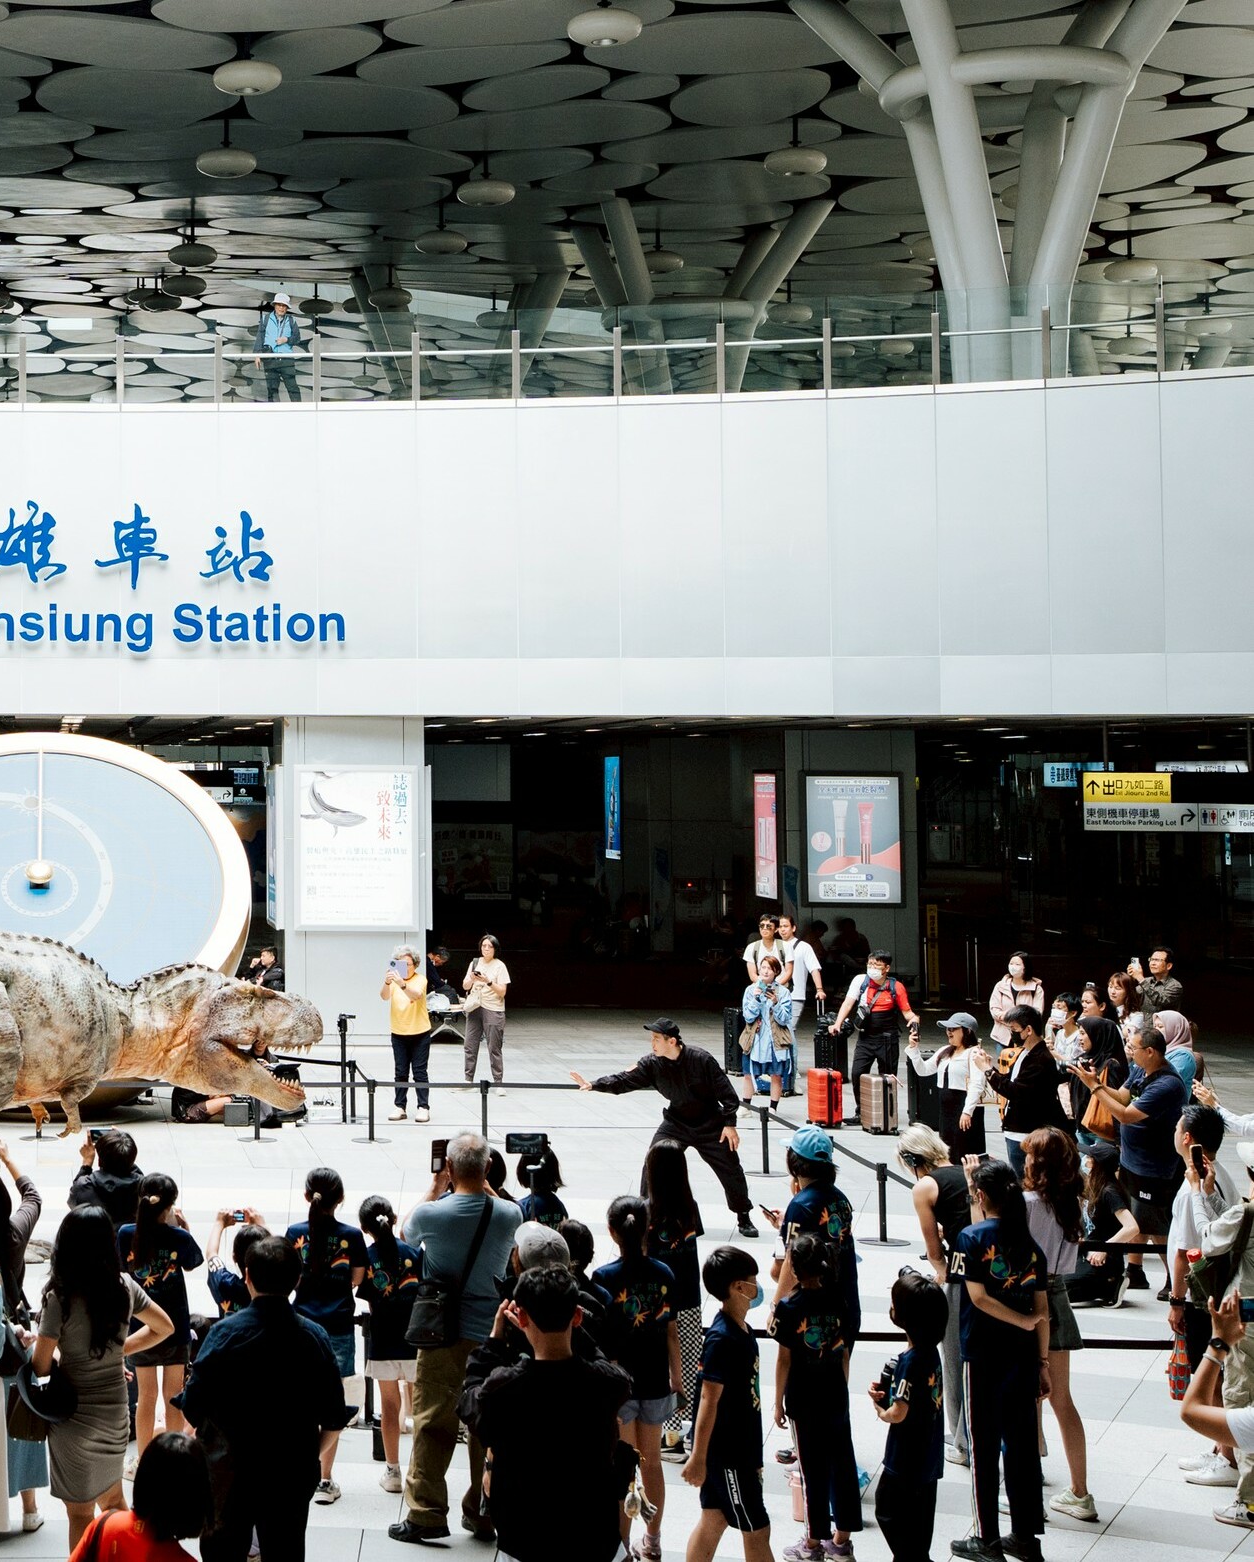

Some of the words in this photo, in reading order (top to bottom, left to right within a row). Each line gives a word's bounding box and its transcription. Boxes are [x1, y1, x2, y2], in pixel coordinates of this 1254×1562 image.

[173, 603, 346, 642] Station
[377, 790, 391, 841] 致未來
[1086, 808, 1160, 819] 東側機車停車場
[1138, 819, 1164, 827] Parking
[951, 1252, 966, 1275] 05
[896, 1378, 913, 1401] 05
